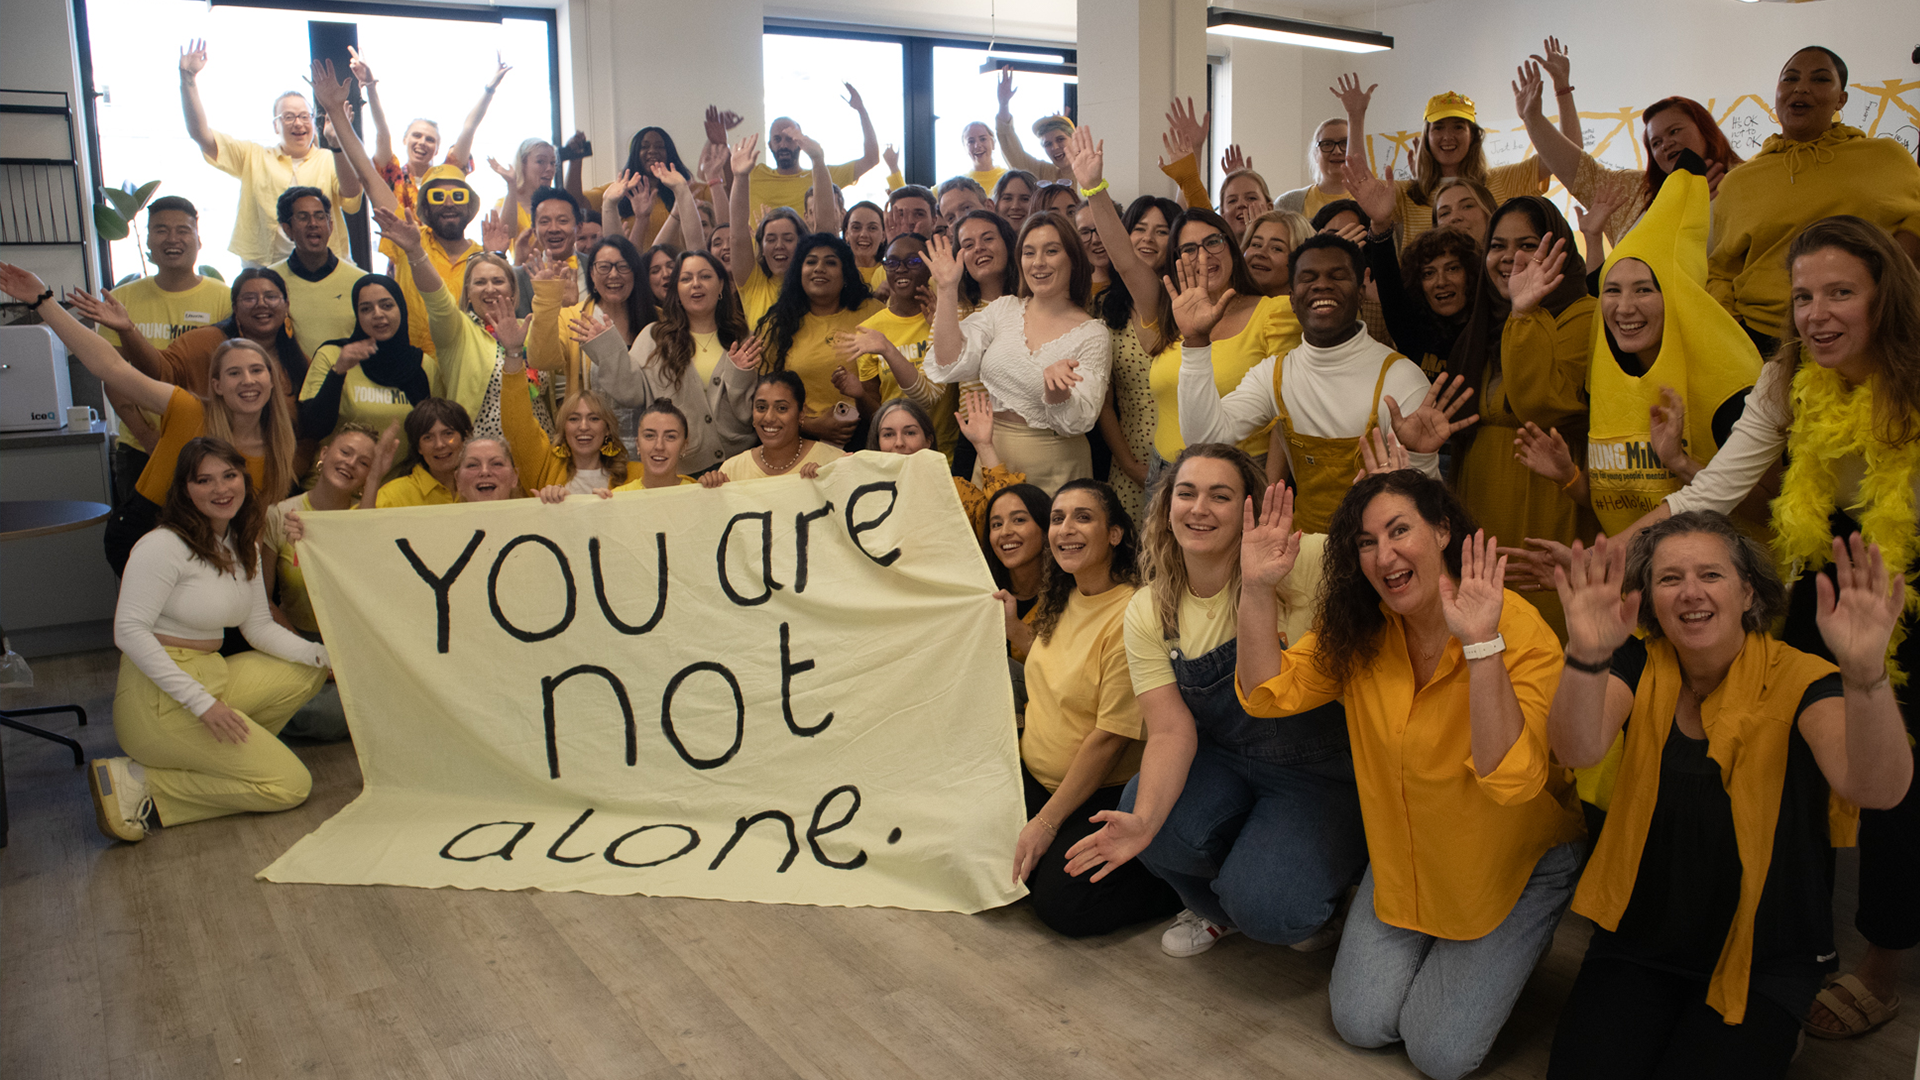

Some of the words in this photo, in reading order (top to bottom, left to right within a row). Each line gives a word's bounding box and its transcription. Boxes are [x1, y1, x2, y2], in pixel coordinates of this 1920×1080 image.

[1489, 139, 1511, 155] Just
[1745, 127, 1757, 135] to
[1746, 133, 1762, 148] OK
[716, 481, 902, 607] are
[541, 622, 834, 780] not
[439, 785, 902, 873] alone.
